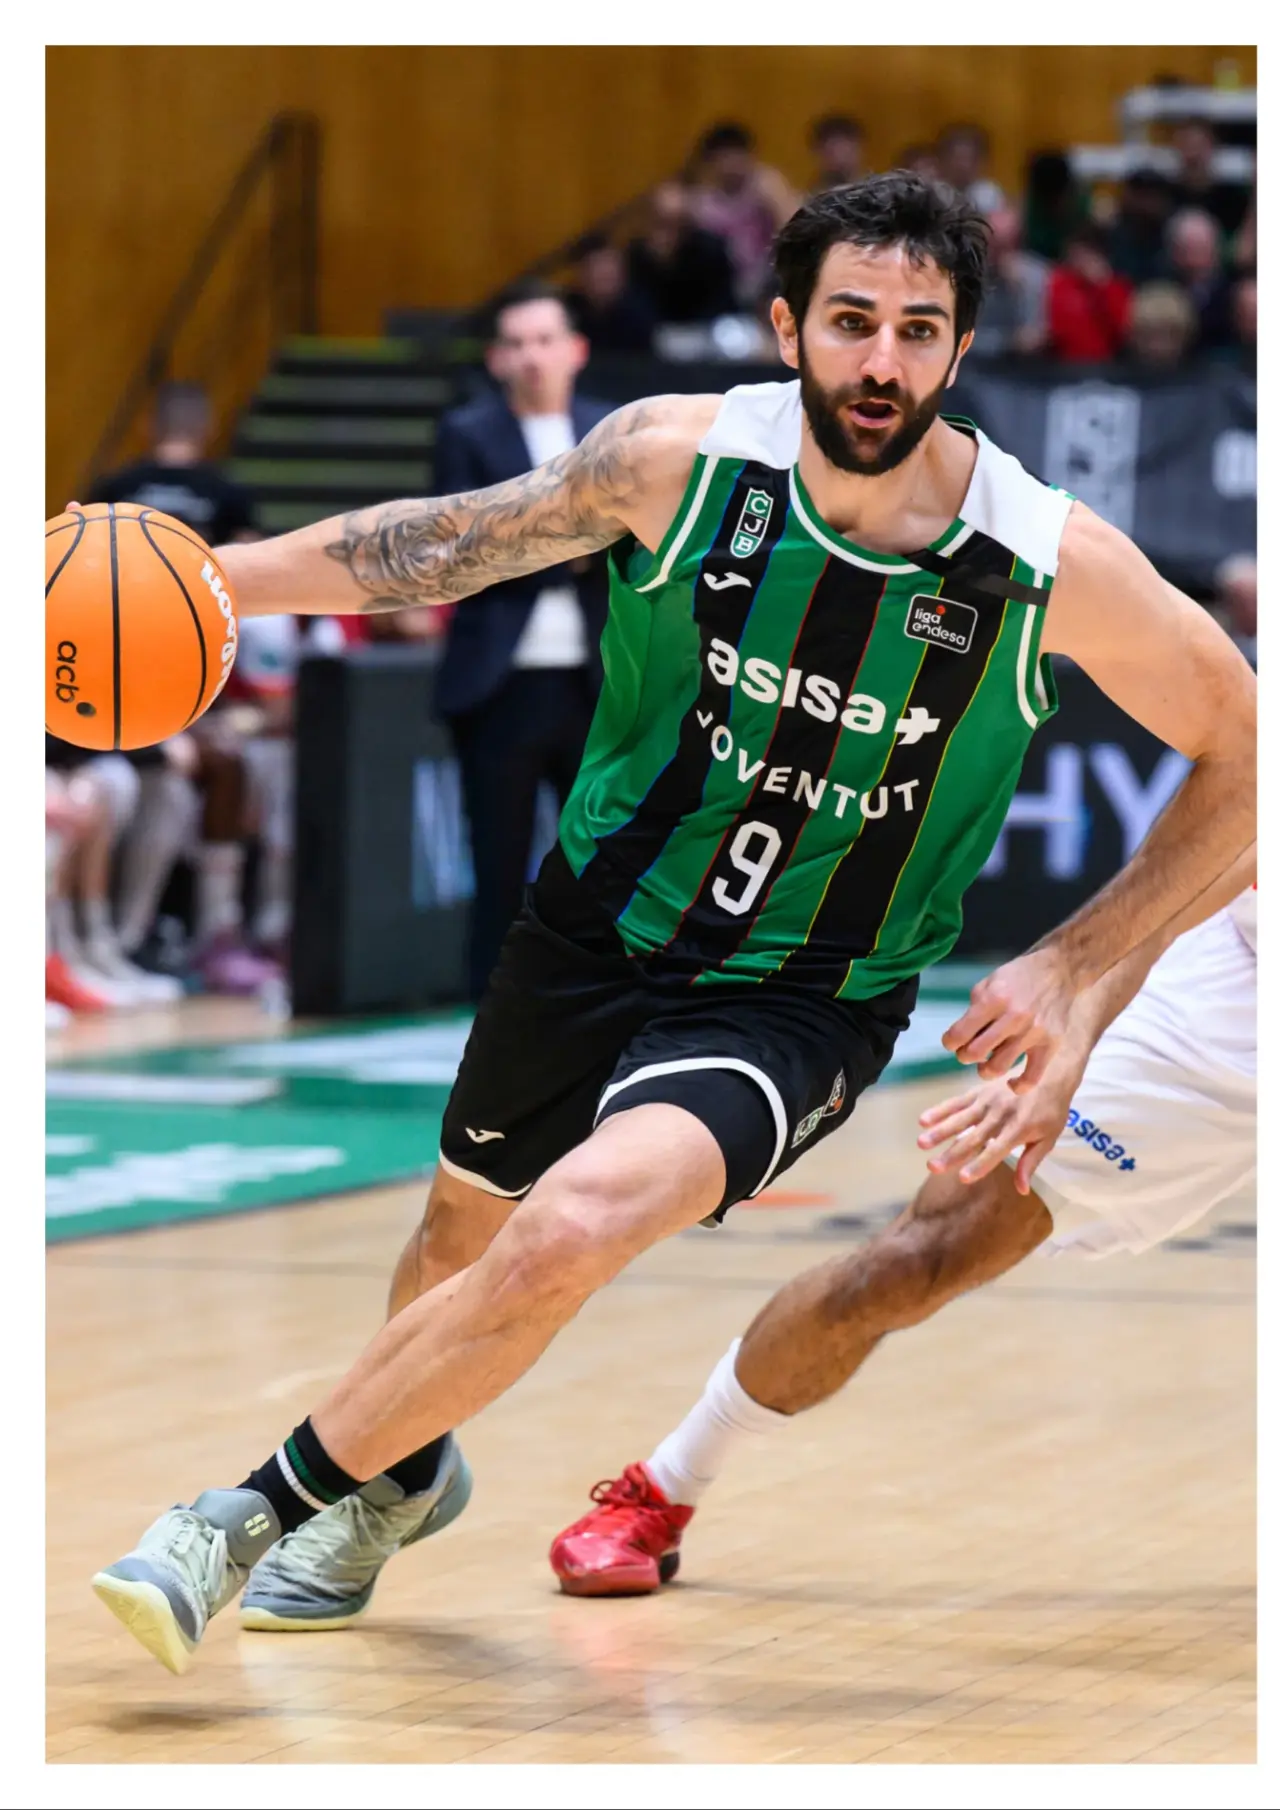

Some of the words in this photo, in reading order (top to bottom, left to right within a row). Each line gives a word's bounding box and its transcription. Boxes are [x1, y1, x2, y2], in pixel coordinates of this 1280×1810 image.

[912, 621, 967, 646] endesa
[914, 607, 942, 625] liga
[56, 640, 80, 703] acb
[711, 820, 782, 916] 9
